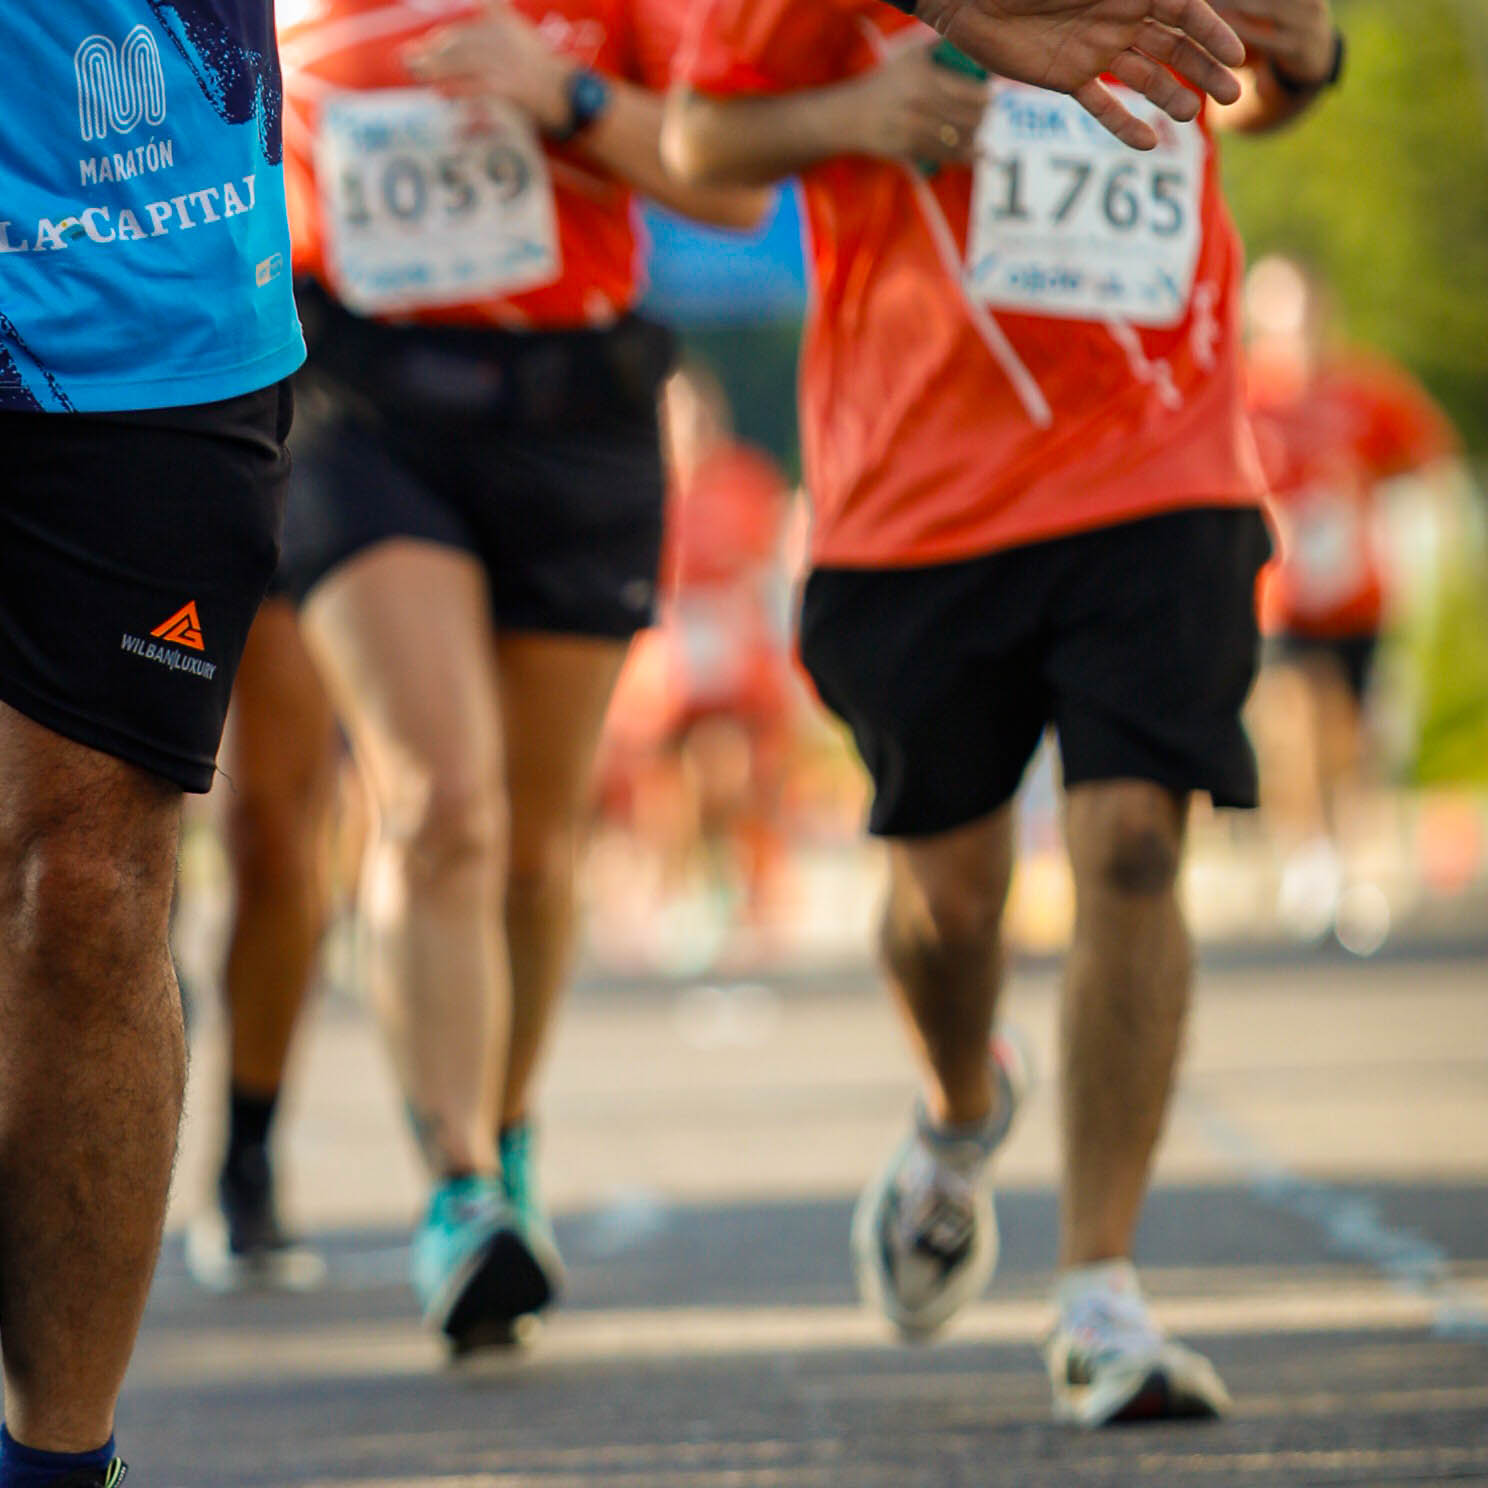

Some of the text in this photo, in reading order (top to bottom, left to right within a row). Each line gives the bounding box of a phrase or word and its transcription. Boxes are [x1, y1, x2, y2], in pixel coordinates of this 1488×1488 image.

[78, 135, 174, 187] MARATÓN
[339, 144, 533, 230] 1059
[990, 154, 1187, 238] 1765
